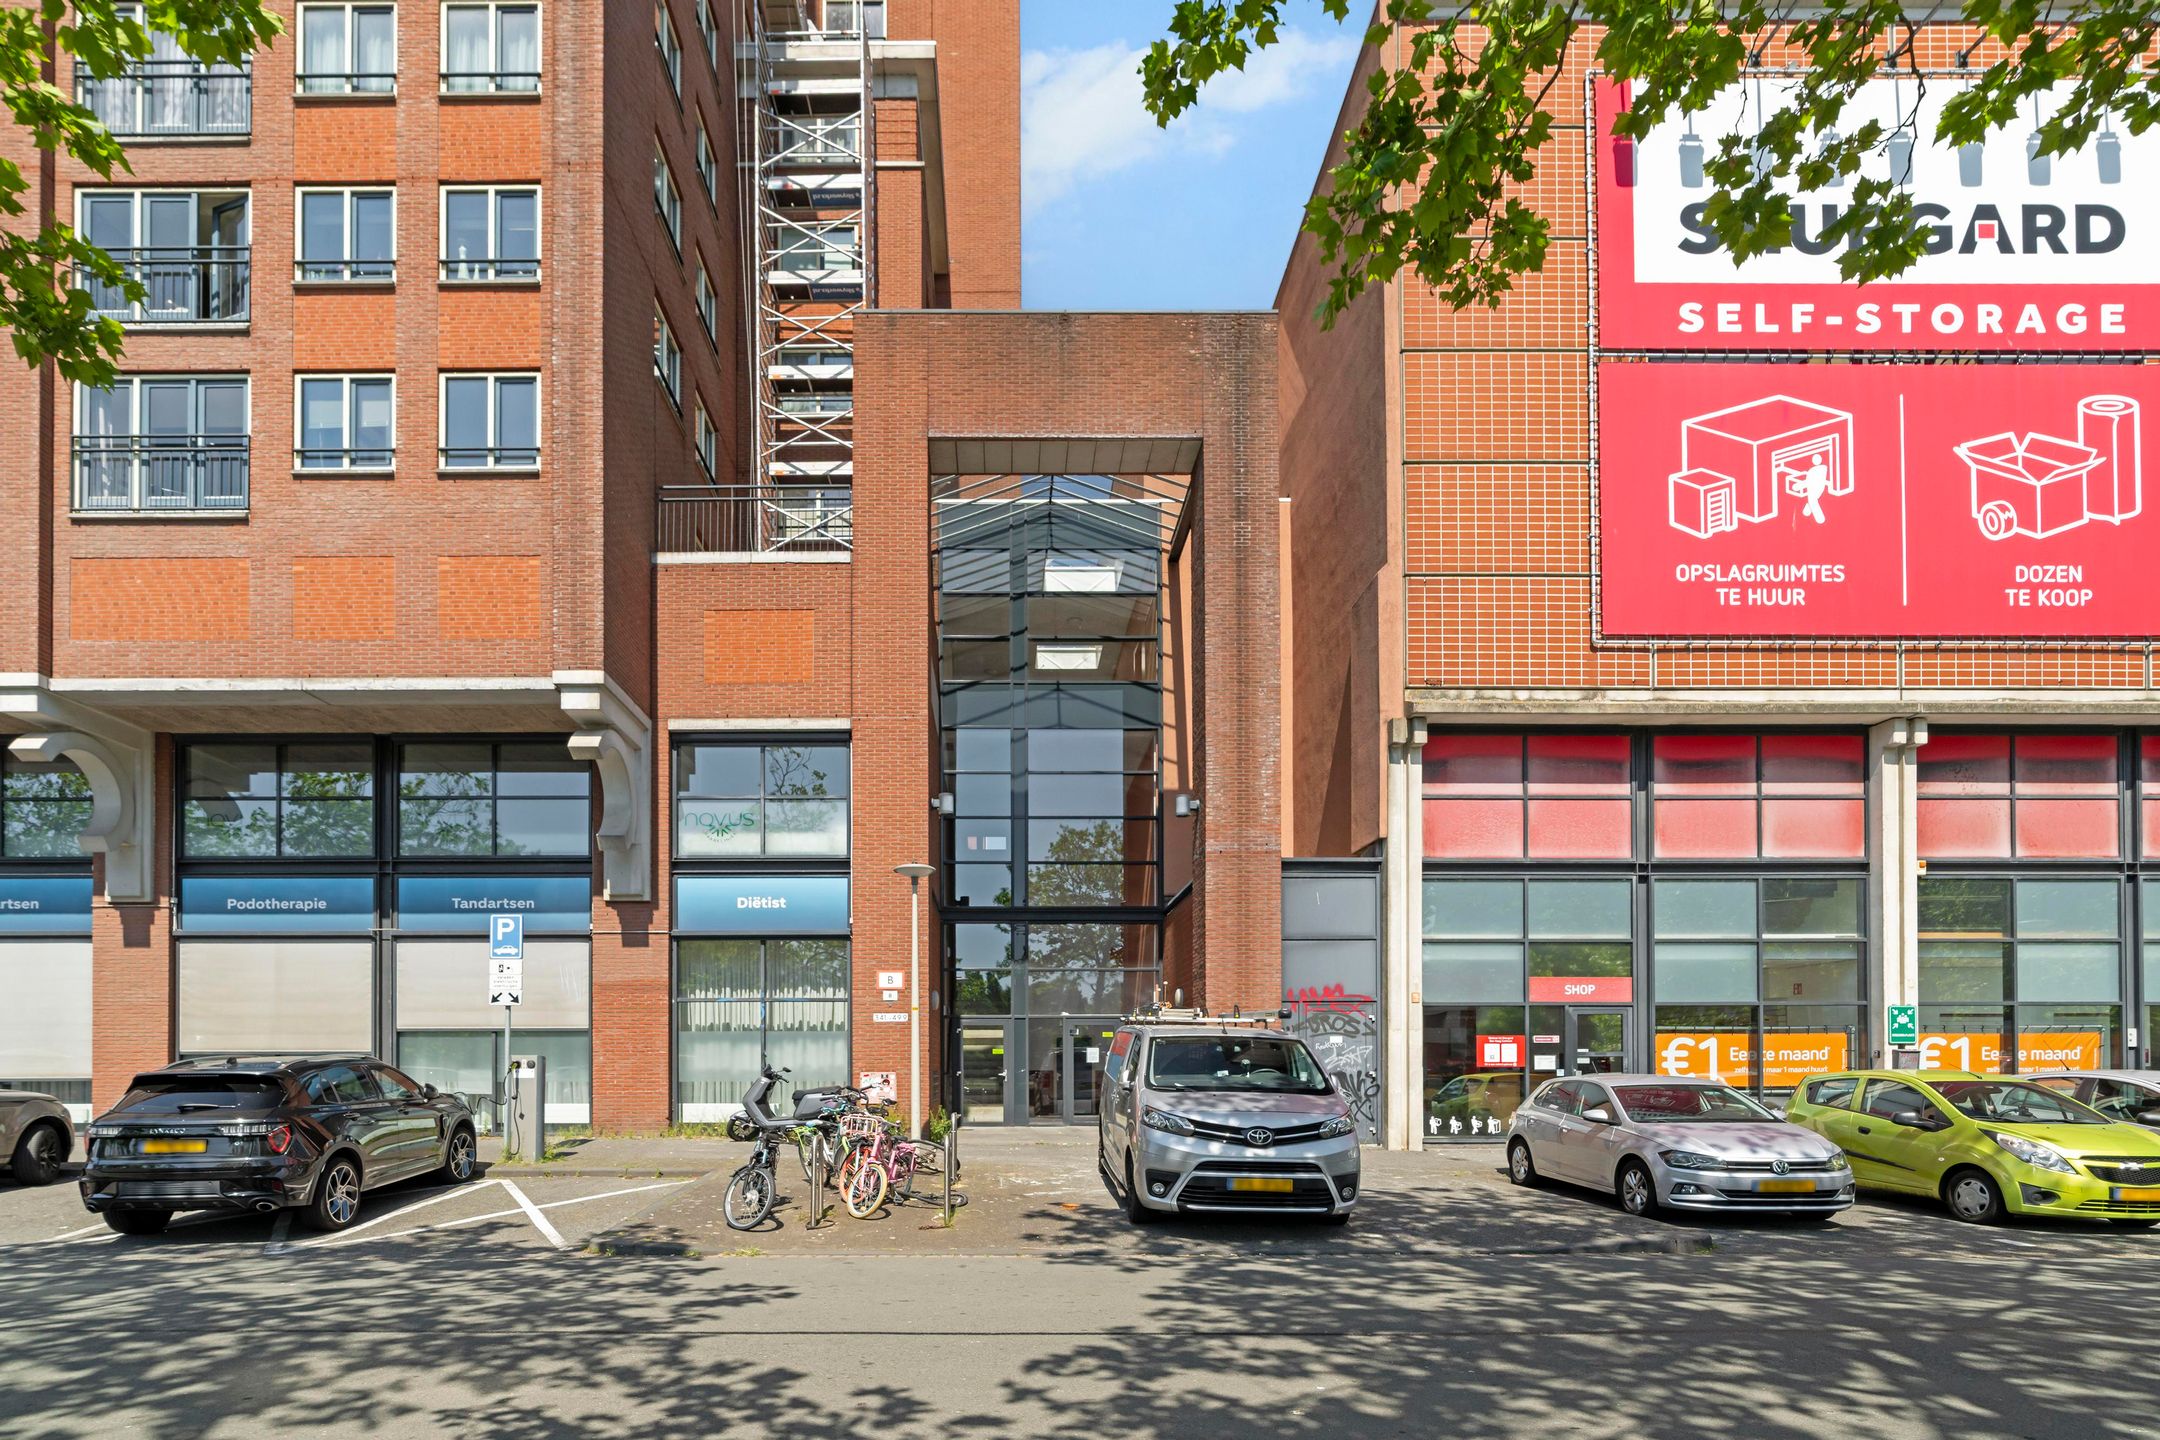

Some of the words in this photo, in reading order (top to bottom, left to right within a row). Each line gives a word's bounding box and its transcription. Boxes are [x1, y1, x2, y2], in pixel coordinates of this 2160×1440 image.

[1678, 203, 2126, 254] SUGARD
[1678, 302, 2126, 333] SELF-STORAGE
[1676, 564, 1845, 582] OPSLAGRUIMTES
[2015, 566, 2082, 583] DOZEN
[1716, 588, 1741, 606] TE
[1748, 588, 1805, 606] HUUR
[2005, 589, 2030, 607] TE
[2038, 589, 2093, 607] KOOP
[0, 899, 39, 909] rtsen
[227, 898, 327, 911] Podotherapie
[452, 898, 535, 909] Tandartsen
[737, 896, 786, 908] Diëtist
[497, 918, 515, 941] P
[887, 975, 894, 984] B
[1564, 984, 1596, 995] SHOP
[1661, 1037, 1719, 1081] €1
